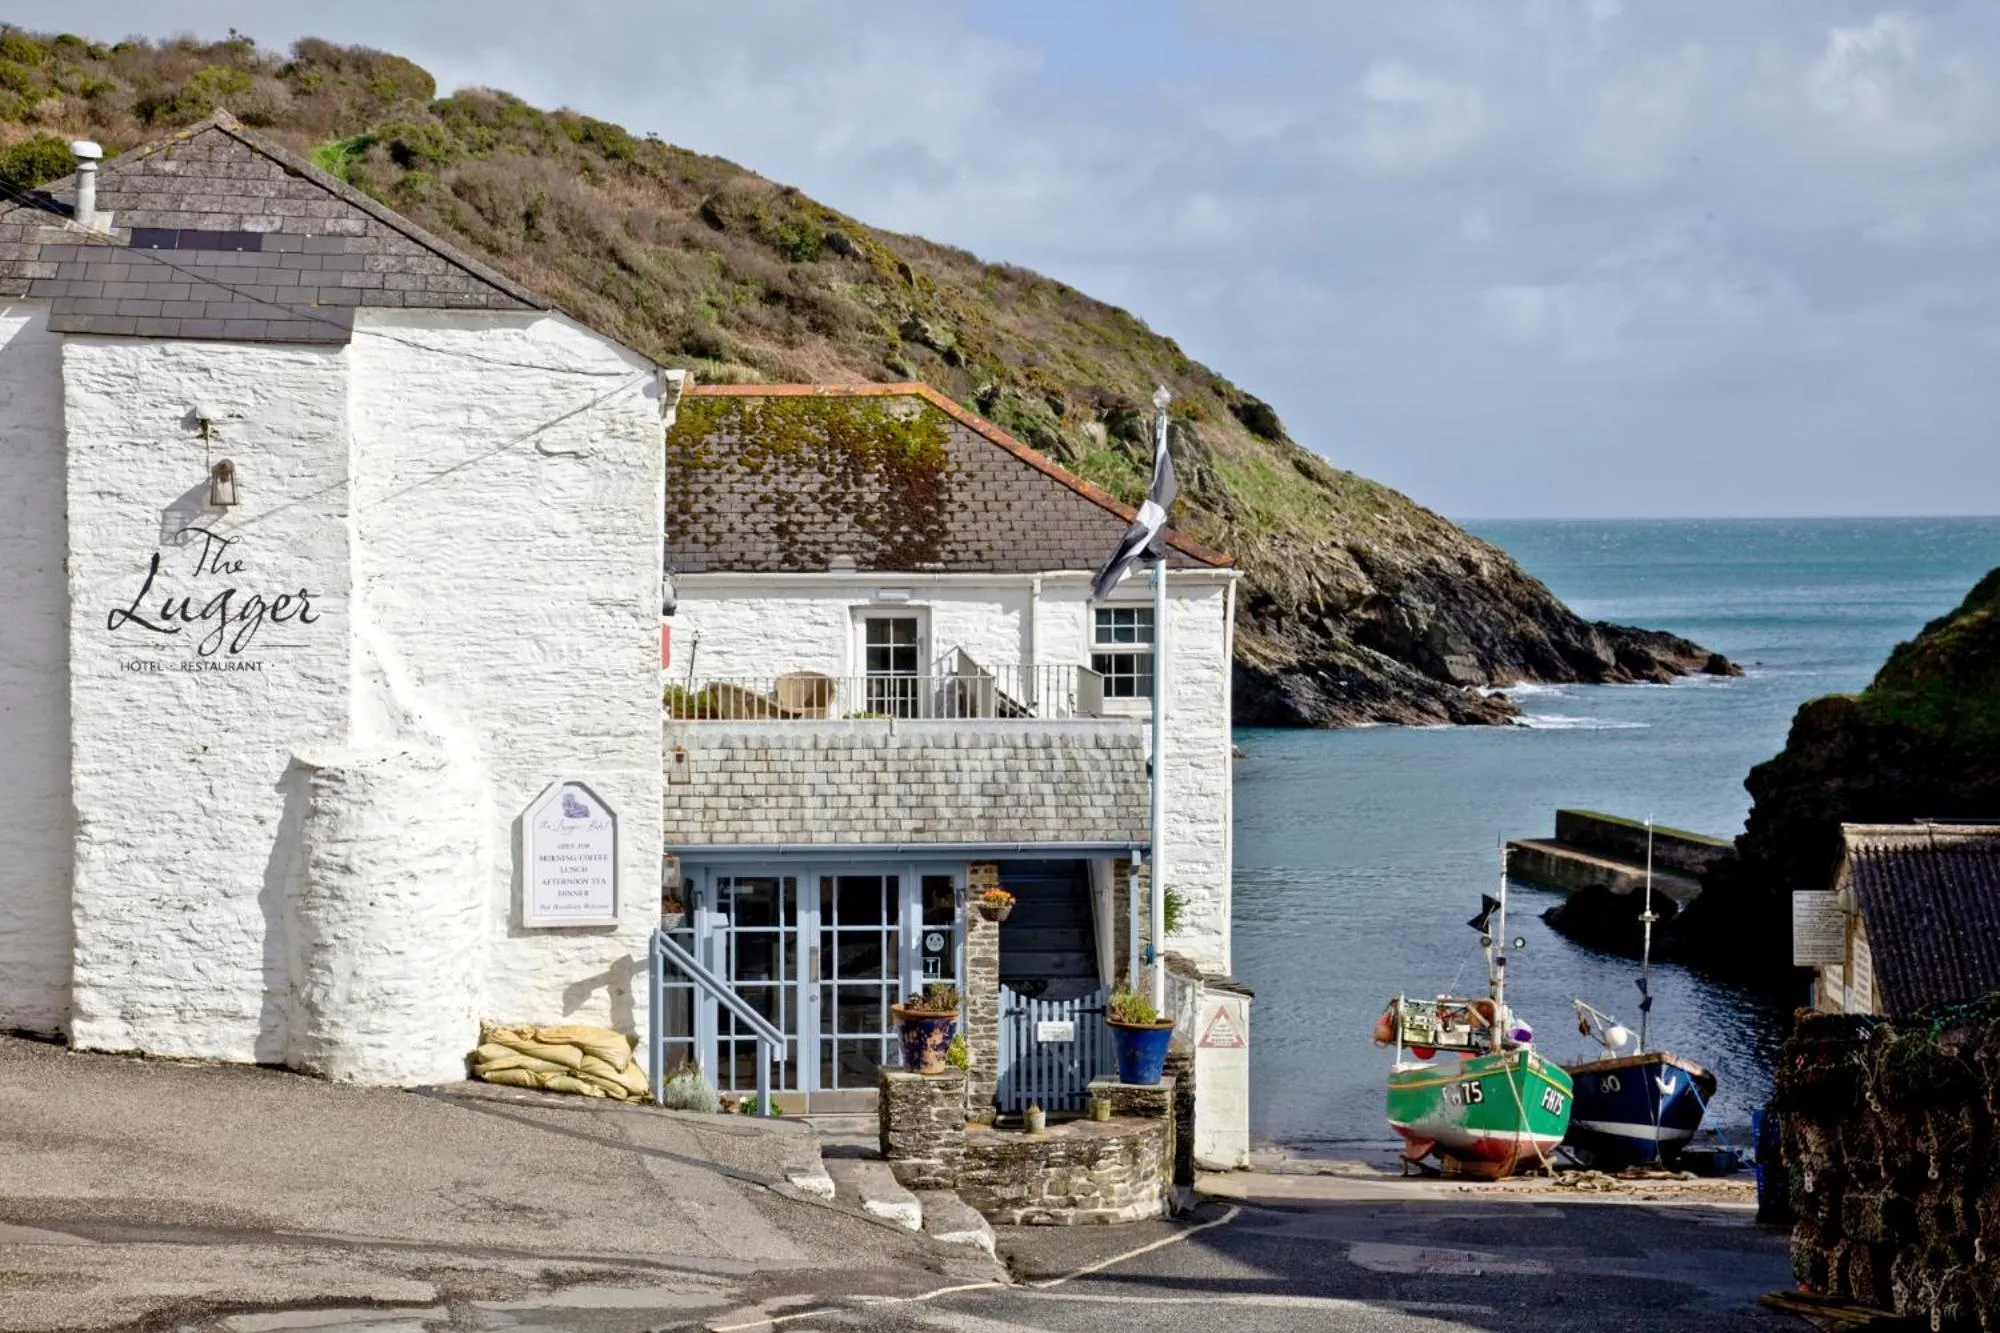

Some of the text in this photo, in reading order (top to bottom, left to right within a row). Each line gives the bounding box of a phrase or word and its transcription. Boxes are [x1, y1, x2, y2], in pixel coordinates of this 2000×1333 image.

[174, 527, 248, 577] The
[107, 552, 321, 657] Lugger
[120, 660, 264, 672] HOTEL RESTAURANT
[539, 854, 577, 862] MORNING
[557, 889, 589, 897] DINNER
[1541, 1086, 1564, 1116] FH75
